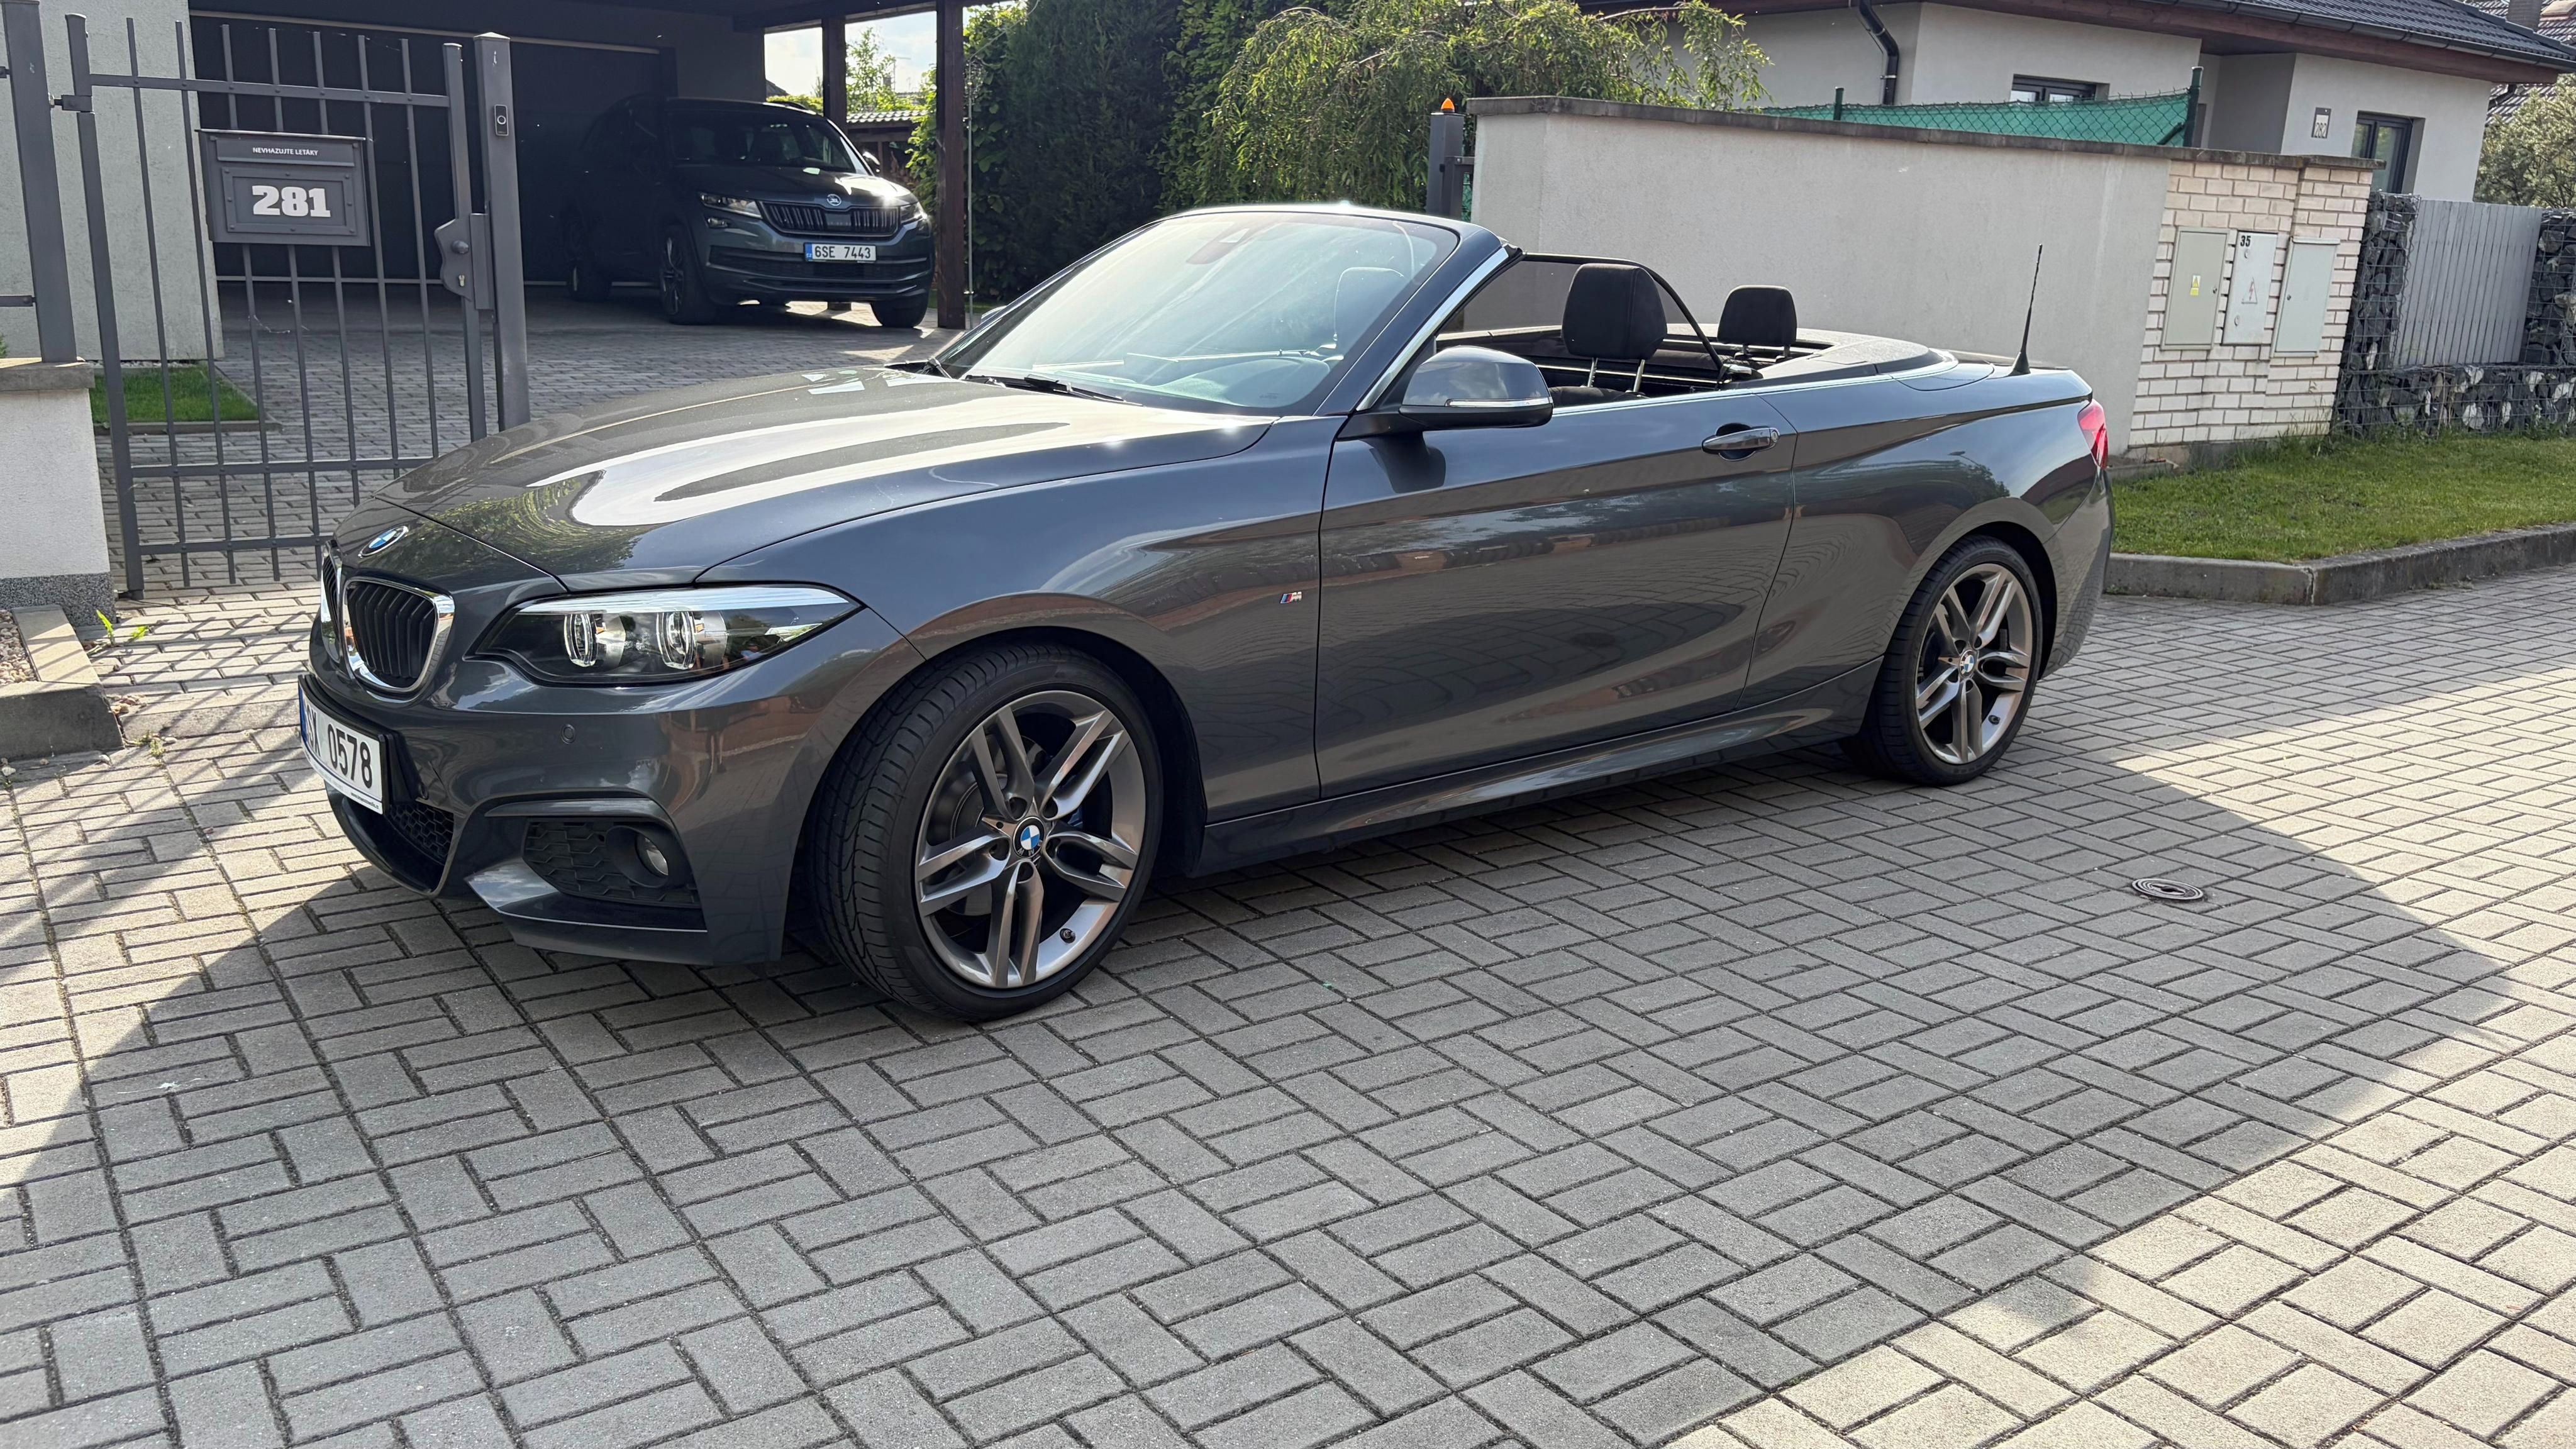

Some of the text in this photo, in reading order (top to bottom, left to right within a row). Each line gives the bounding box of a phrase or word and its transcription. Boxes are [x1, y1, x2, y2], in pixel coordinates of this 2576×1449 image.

[252, 185, 331, 218] 281
[814, 246, 871, 258] 6SE 7443
[2240, 235, 2251, 247] 35
[304, 699, 321, 757] SX
[328, 724, 372, 789] 0578
